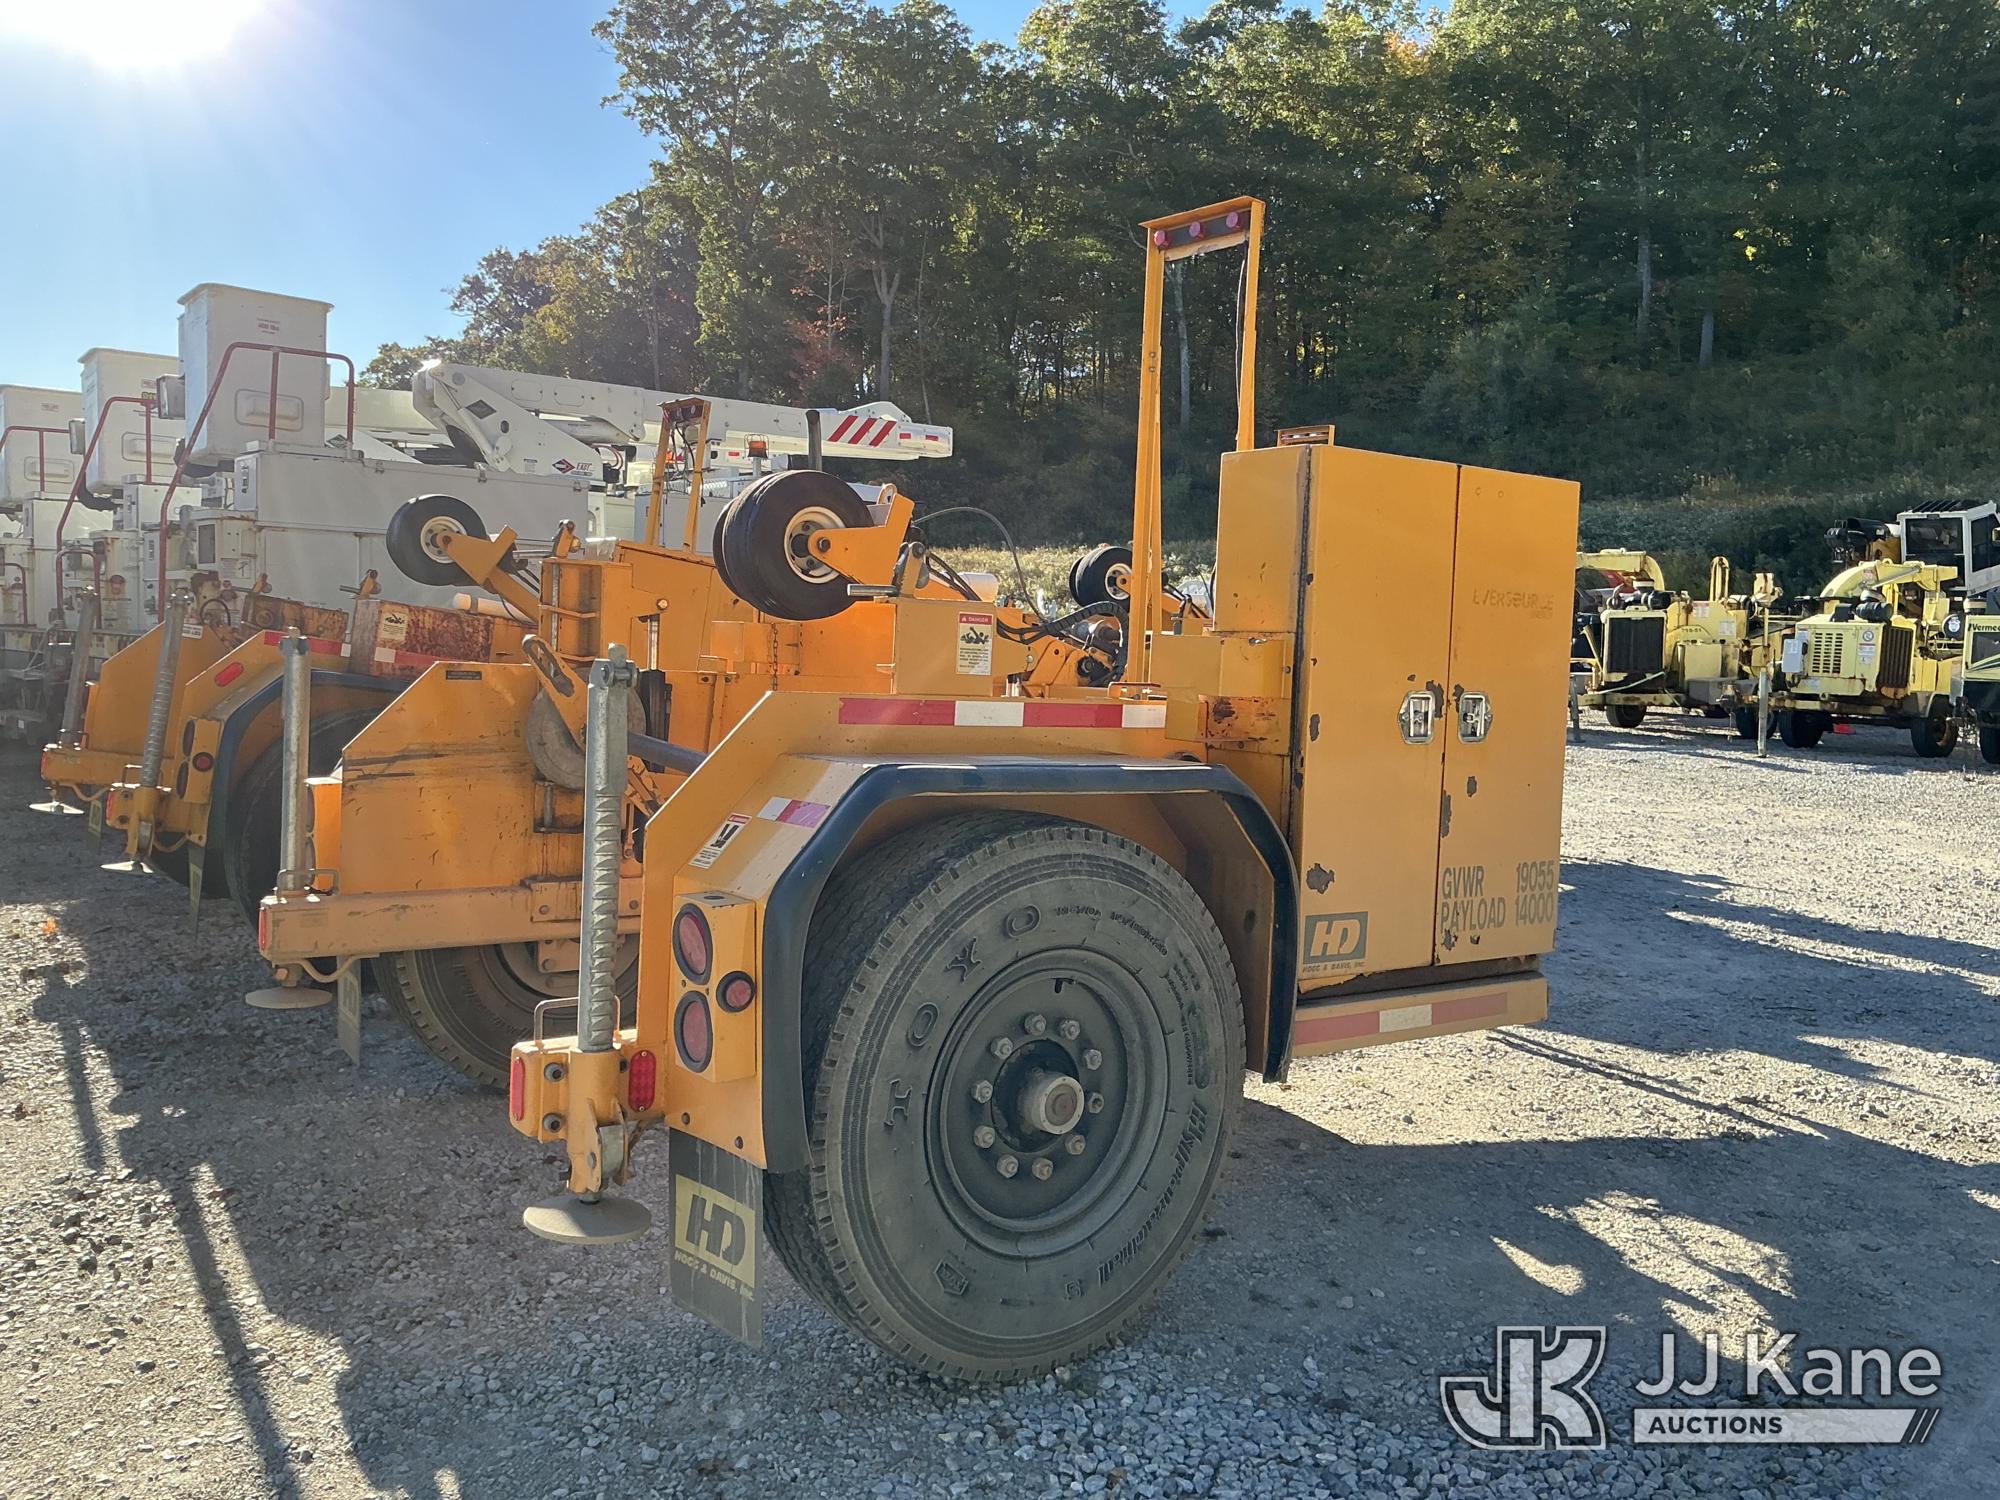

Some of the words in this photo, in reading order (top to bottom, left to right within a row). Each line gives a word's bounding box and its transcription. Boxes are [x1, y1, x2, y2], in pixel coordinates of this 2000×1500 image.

[1442, 865, 1485, 899] GVWR
[1515, 860, 1555, 893] 19055
[1440, 897, 1506, 934] PAYLOAD
[1515, 892, 1554, 926] 14000
[1310, 919, 1361, 956] HD
[686, 1194, 745, 1265] HD
